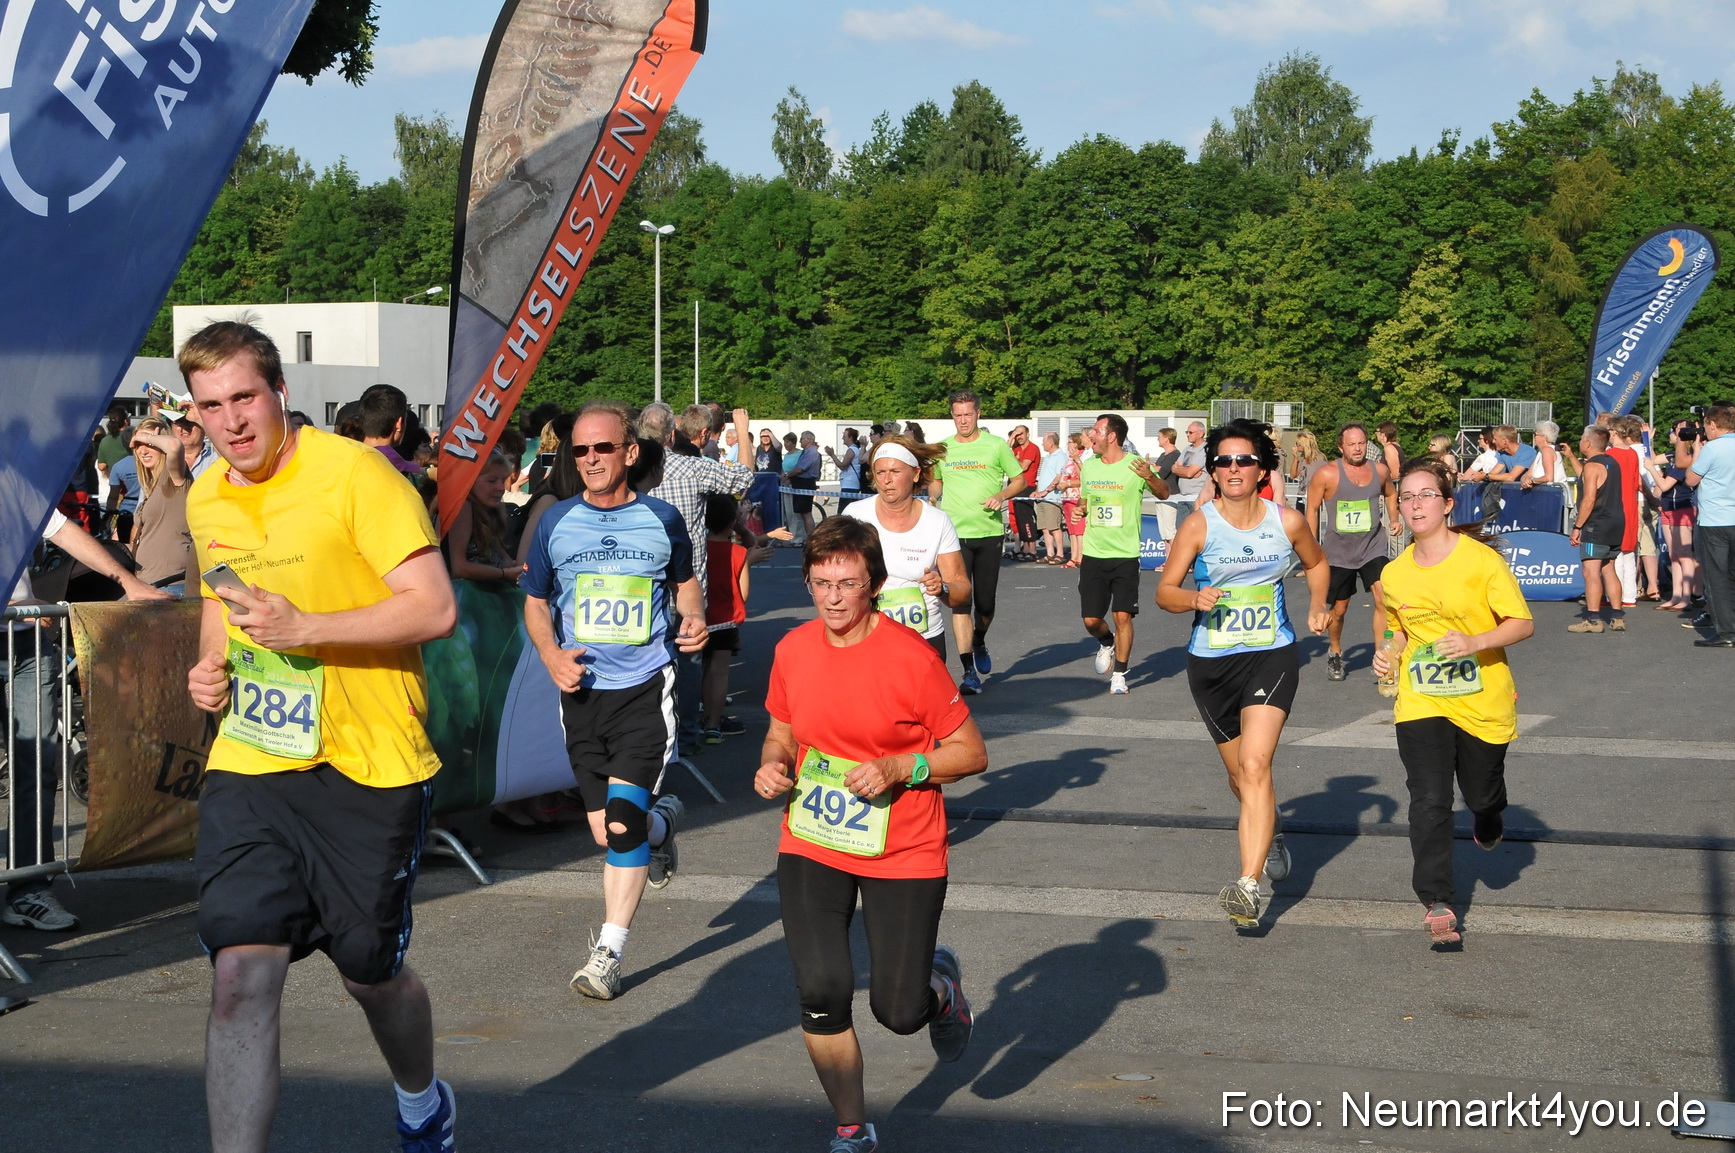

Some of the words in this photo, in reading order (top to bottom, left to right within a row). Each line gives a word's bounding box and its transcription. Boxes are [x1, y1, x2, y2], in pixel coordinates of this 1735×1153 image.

[1654, 296, 1675, 325] Druck
[1685, 247, 1708, 281] Medien
[1596, 277, 1681, 387] Frischmann
[1612, 370, 1642, 415] mann-net.de
[1097, 507, 1113, 520] 35
[1345, 512, 1361, 524] 17
[565, 550, 655, 564] SCHABMÜLLER
[1218, 554, 1280, 564] SCHABMÜLLER
[597, 565, 621, 573] TEAM
[1506, 561, 1579, 577] ischer
[579, 598, 644, 628] 1201
[1210, 606, 1272, 633] 1202
[1410, 659, 1477, 685] 1270
[231, 676, 315, 734] 1284
[264, 728, 296, 740] Gottschalk
[264, 737, 283, 746] Tiroler
[283, 740, 294, 748] Hof
[802, 785, 872, 832] 492
